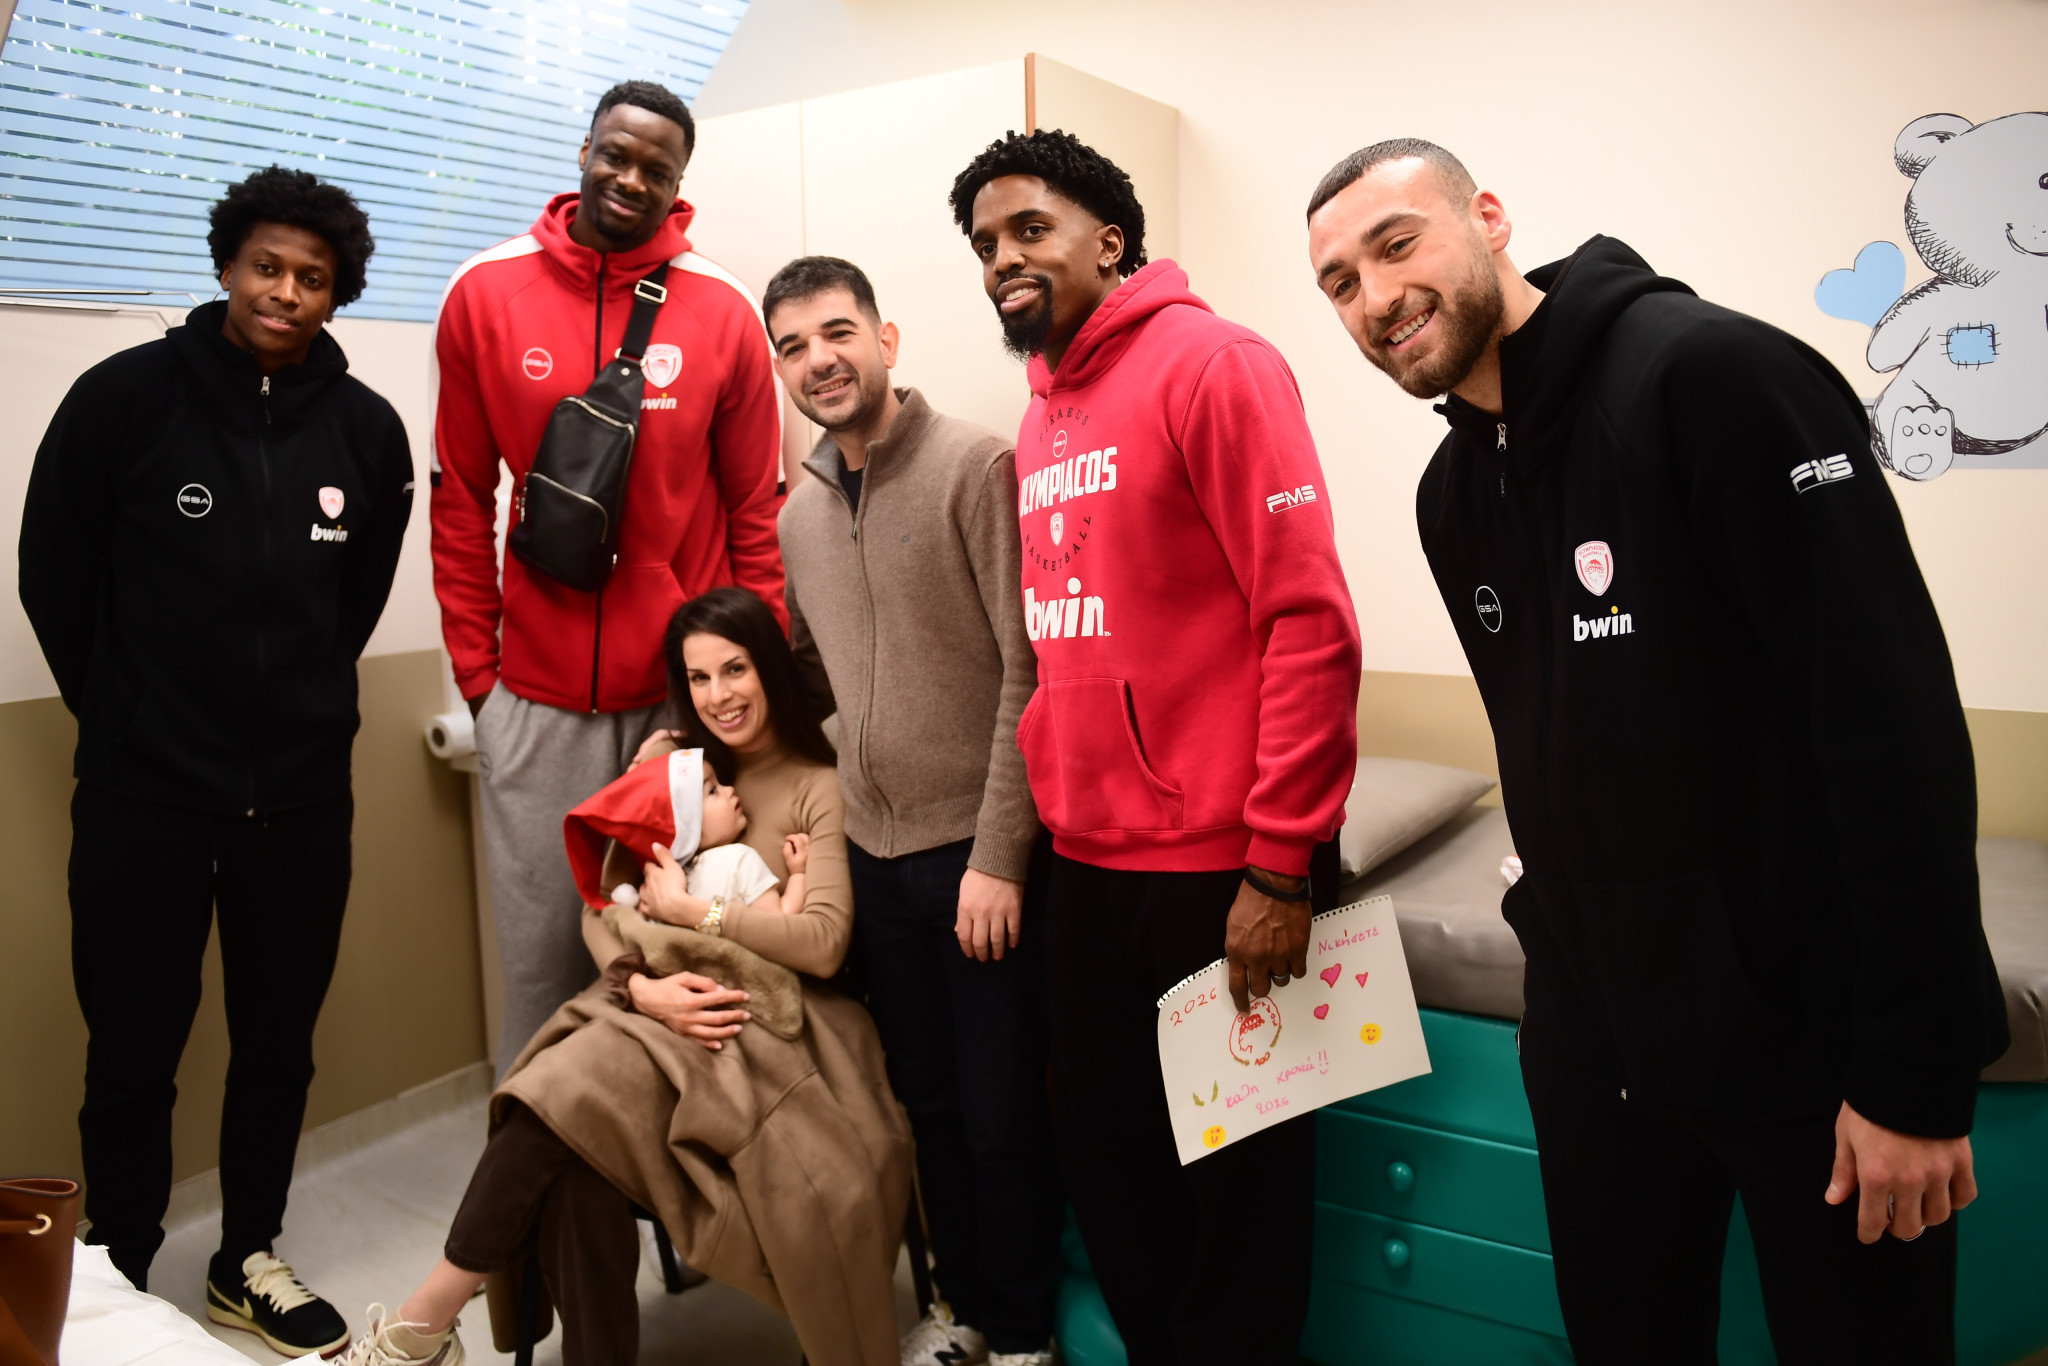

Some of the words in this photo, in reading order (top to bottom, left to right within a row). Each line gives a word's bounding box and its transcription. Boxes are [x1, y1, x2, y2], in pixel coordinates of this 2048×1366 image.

[1789, 453, 1853, 493] FMS
[180, 494, 209, 506] GSA
[1266, 484, 1317, 513] FMS
[310, 523, 348, 542] bwin
[1024, 576, 1104, 643] bwin
[1478, 603, 1499, 613] GSA
[1572, 605, 1632, 642] bwin
[1170, 987, 1217, 1028] 2026
[1256, 1097, 1290, 1115] 2026
